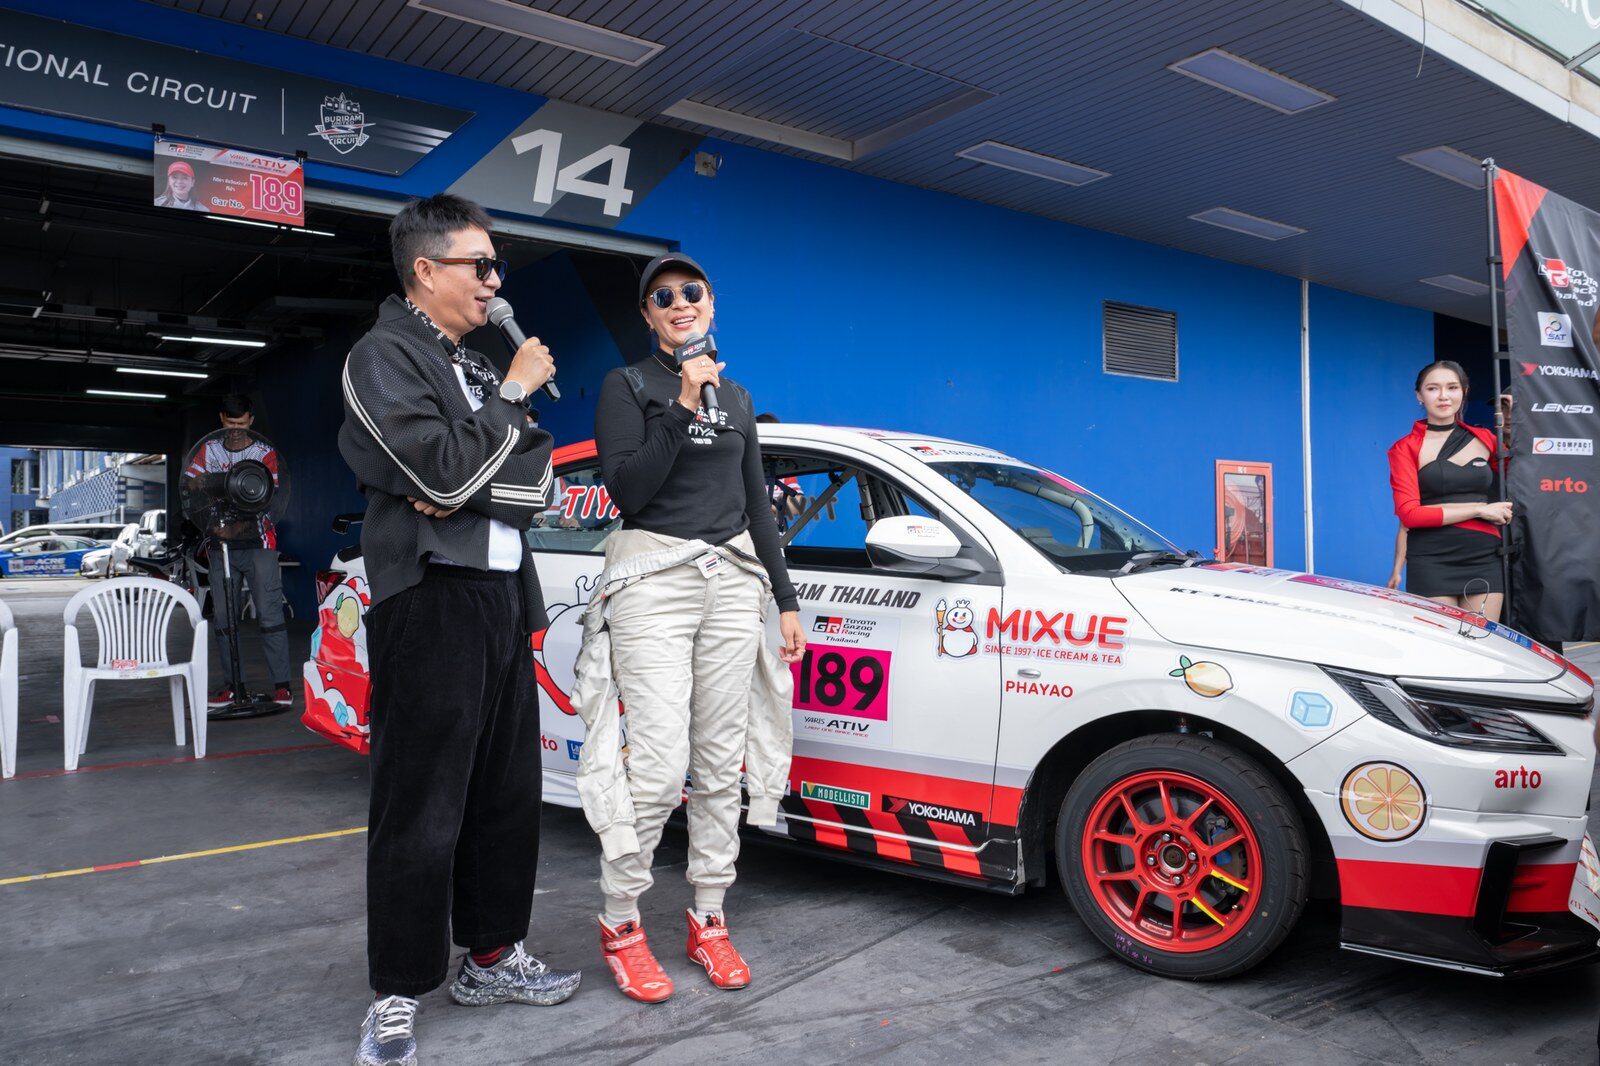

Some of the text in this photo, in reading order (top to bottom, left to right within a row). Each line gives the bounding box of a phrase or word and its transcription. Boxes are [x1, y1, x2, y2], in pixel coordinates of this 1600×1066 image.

[127, 72, 257, 114] CIRCUIT
[324, 114, 361, 123] BURIRAM
[251, 158, 287, 170] ATIV
[511, 128, 634, 217] 14
[211, 197, 245, 210] Car No.
[250, 173, 302, 216] 189
[1547, 333, 1567, 341] SAT
[1538, 365, 1600, 380] YOKOHAMA
[1531, 403, 1594, 414] LENSO
[1540, 477, 1588, 494] arto
[564, 485, 621, 519] TIY
[829, 585, 921, 609] THAILAND
[813, 622, 841, 634] GR
[844, 617, 877, 626] TOYOTA
[986, 607, 1128, 650] MIXUE
[825, 635, 860, 645] Thailand
[841, 629, 871, 638] Racing
[985, 645, 1012, 655] SINCE
[1054, 650, 1089, 662] CREAM
[1091, 653, 1099, 662] &
[1101, 654, 1122, 664] TEA
[799, 650, 885, 712] 189
[1005, 680, 1074, 699] PHAYAO
[804, 716, 870, 732] YARIS ATIV
[1494, 765, 1542, 789] arto
[817, 786, 866, 807] MODELLISTA
[908, 802, 976, 827] YOKOHAMA
